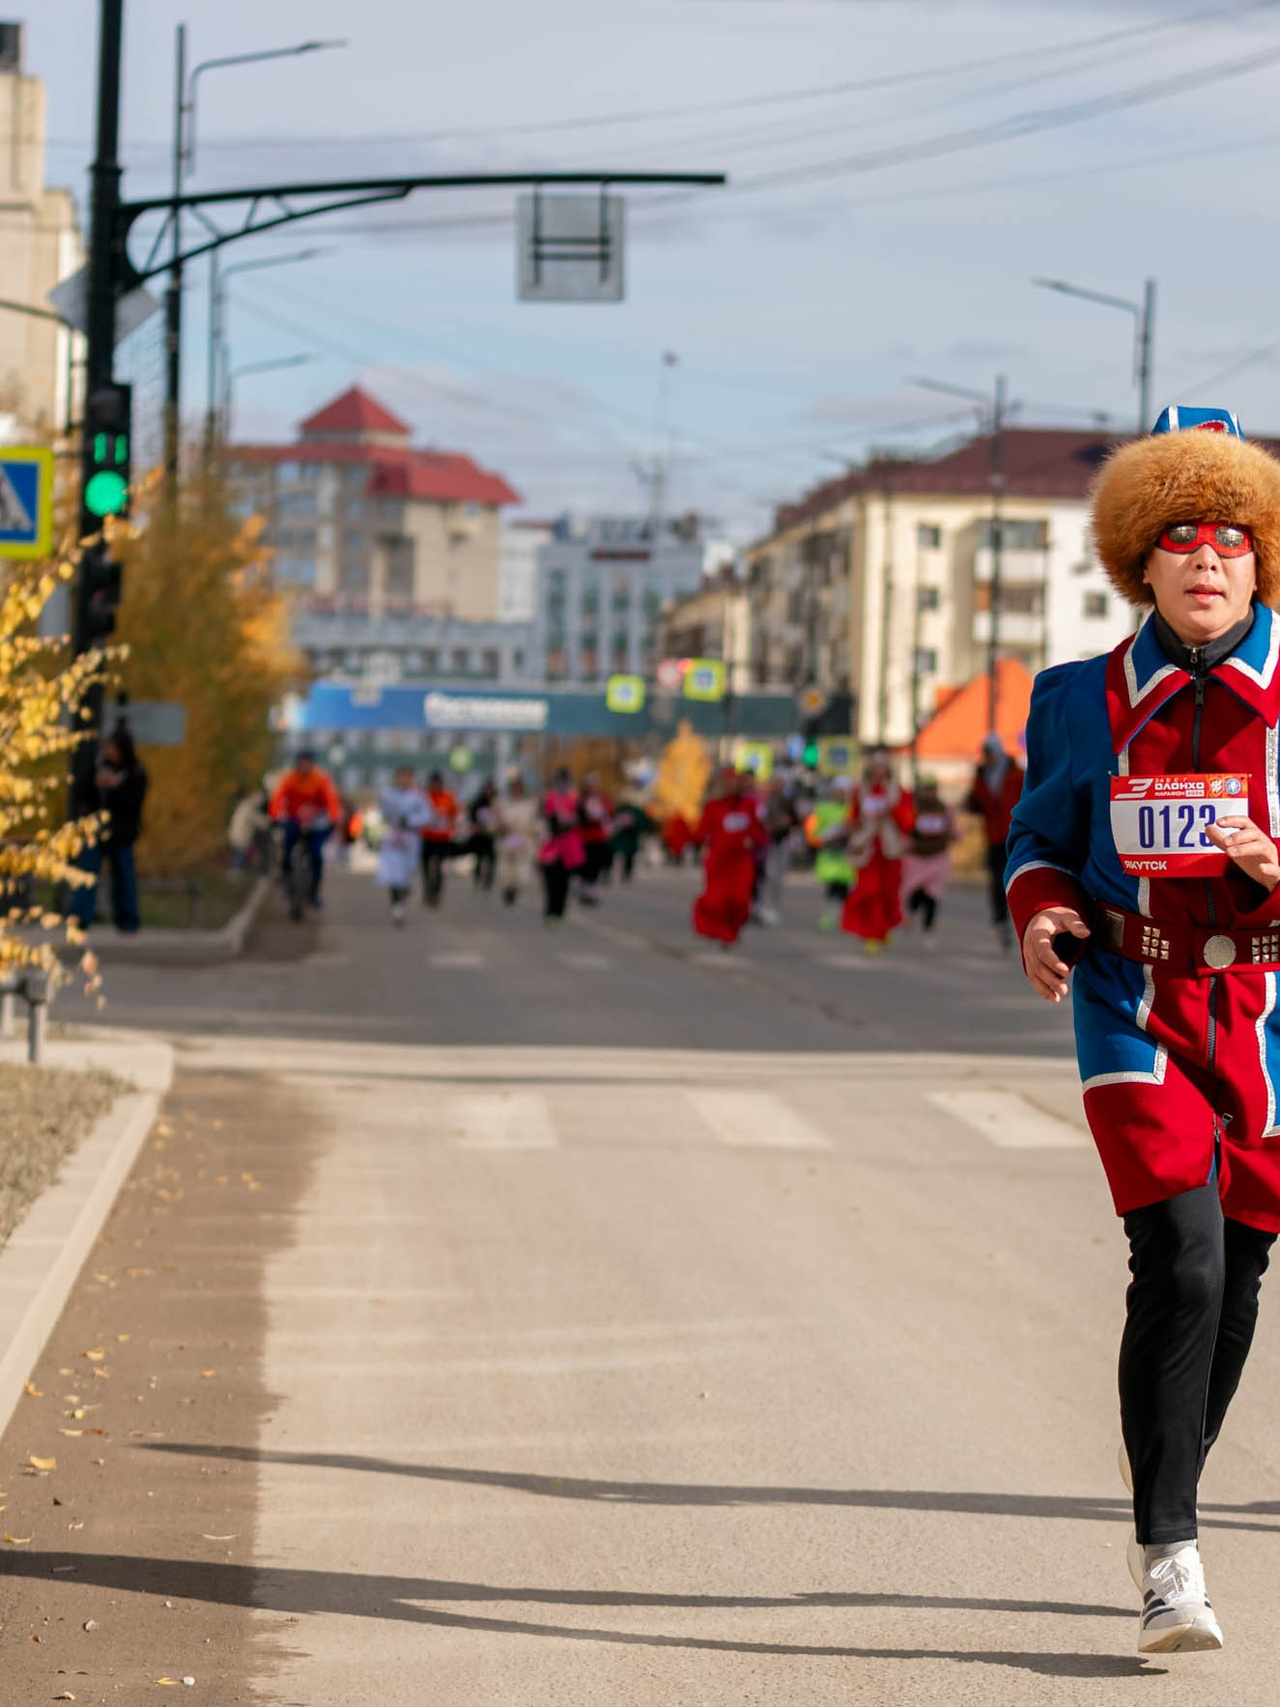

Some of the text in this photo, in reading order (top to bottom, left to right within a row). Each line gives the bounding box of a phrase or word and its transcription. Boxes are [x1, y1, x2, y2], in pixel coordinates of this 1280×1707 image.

[1155, 782, 1205, 790] ОЛОНХО
[1139, 805, 1215, 848] 0123
[1124, 860, 1168, 871] ЯКУТСК
